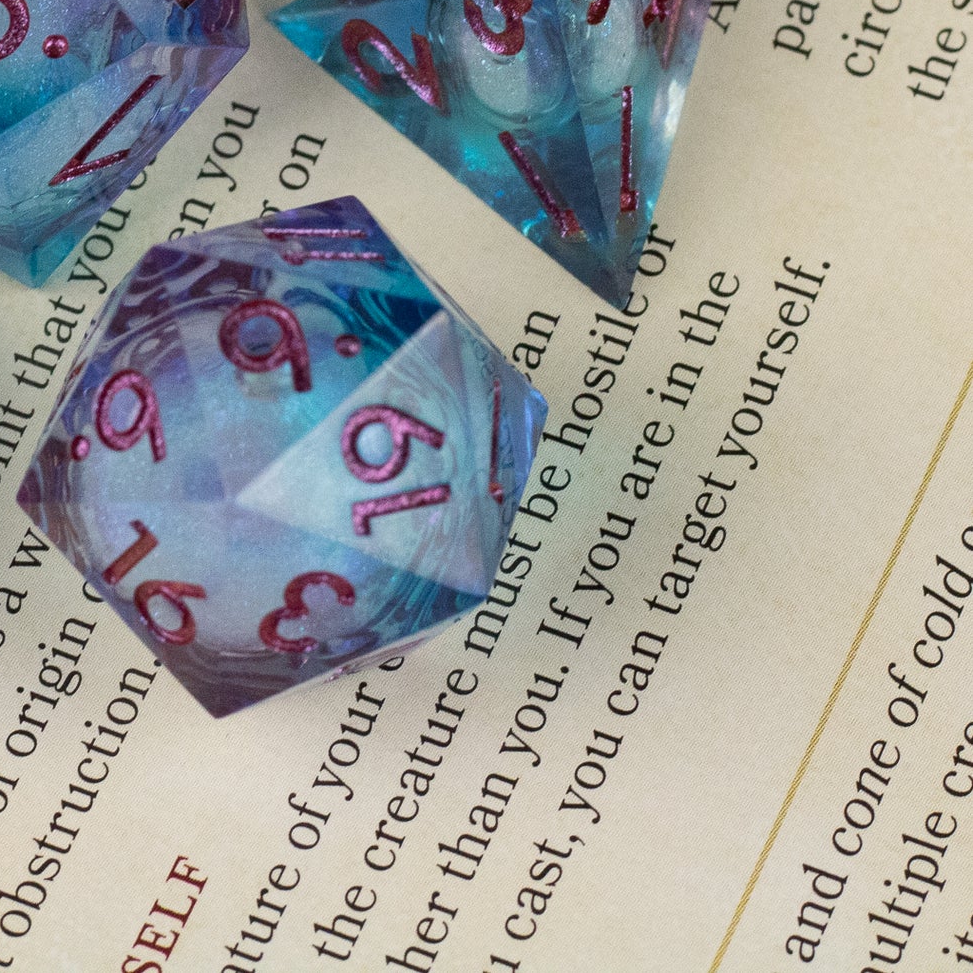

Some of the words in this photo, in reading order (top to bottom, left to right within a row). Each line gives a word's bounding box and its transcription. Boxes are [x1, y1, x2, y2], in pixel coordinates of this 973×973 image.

[340, 18, 449, 118] 2
[906, 27, 967, 101] the
[196, 100, 261, 193] you
[278, 133, 327, 191] on
[498, 131, 581, 238] 1
[620, 86, 639, 212] 1
[635, 220, 677, 277] or
[12, 295, 86, 390] that
[678, 271, 740, 347] the
[544, 289, 650, 455] hostile
[645, 362, 704, 411] in
[342, 404, 452, 536] 19
[517, 461, 573, 526] be
[619, 420, 675, 501] are
[102, 520, 207, 646] 16
[464, 530, 542, 661] must
[504, 834, 586, 941] cast,
[558, 729, 624, 825] you
[607, 630, 669, 716] can
[643, 471, 737, 615] target
[715, 256, 831, 471] yourself.
[572, 511, 637, 606] you
[259, 571, 356, 653] 3
[535, 596, 593, 650] If
[5, 617, 97, 758] origin
[498, 665, 570, 768] you.
[287, 792, 331, 851] of
[312, 680, 386, 802] your
[363, 668, 479, 872] creature
[785, 863, 848, 964] and
[831, 739, 901, 857] cone
[887, 662, 928, 728] of
[912, 555, 971, 669] cold
[437, 772, 520, 881] than
[312, 885, 377, 962] the
